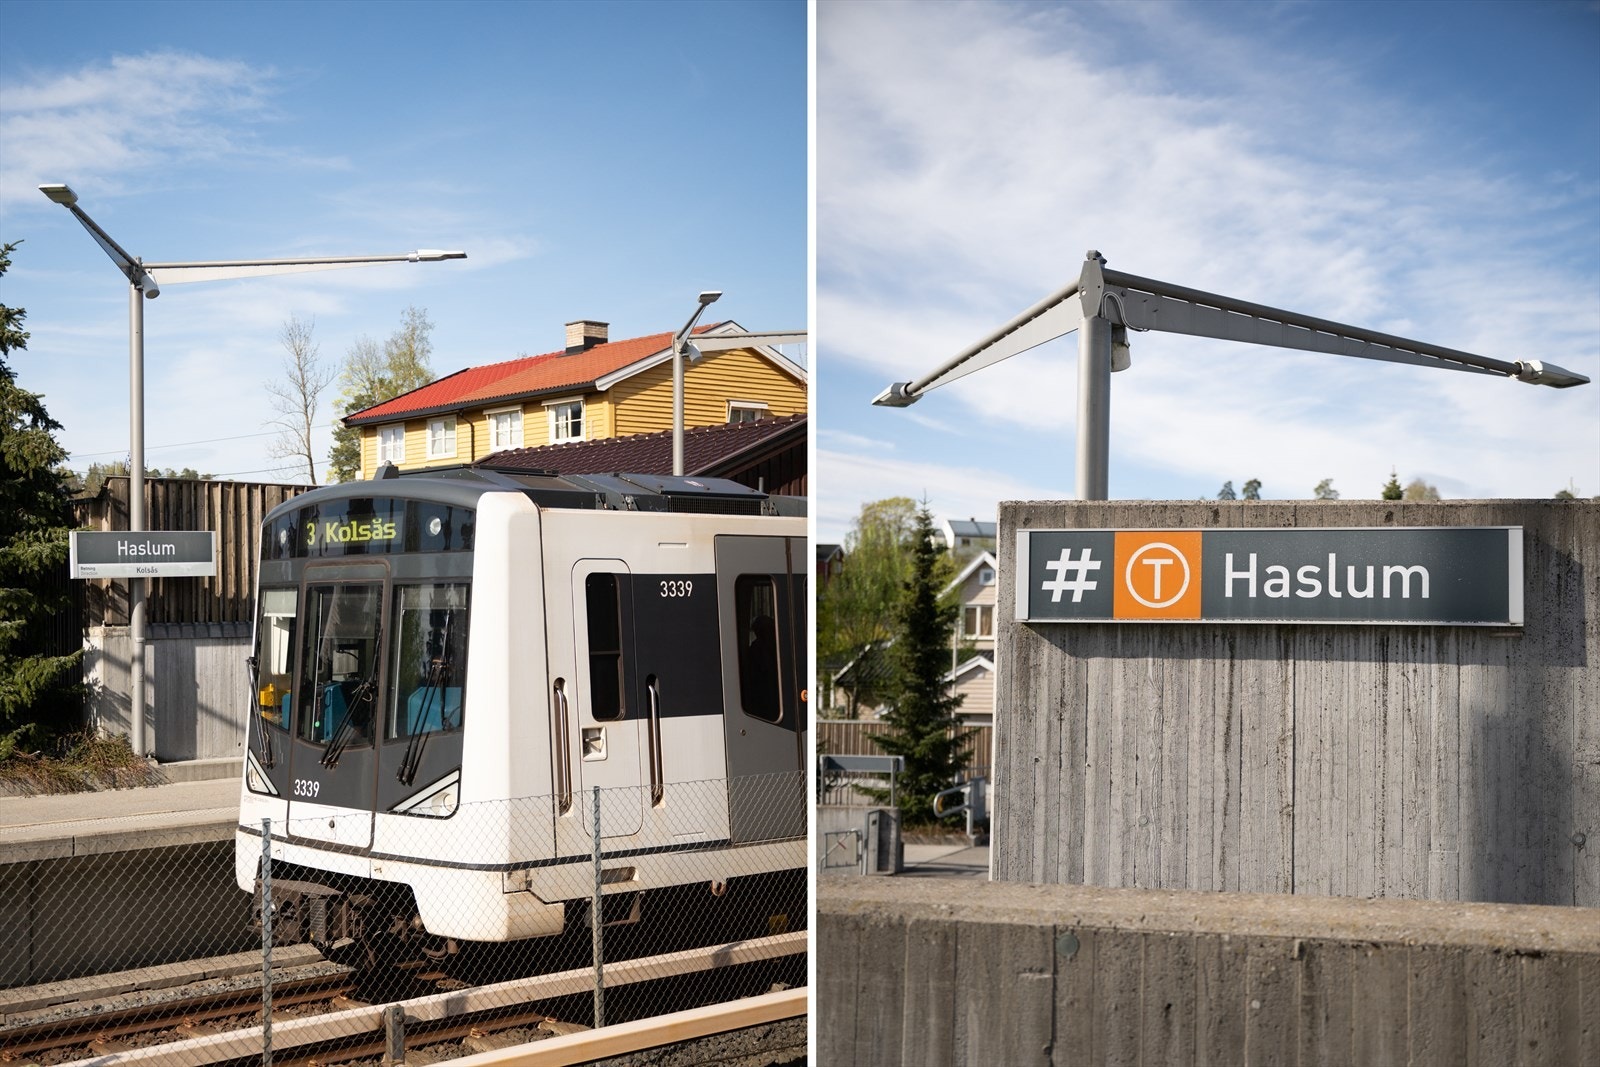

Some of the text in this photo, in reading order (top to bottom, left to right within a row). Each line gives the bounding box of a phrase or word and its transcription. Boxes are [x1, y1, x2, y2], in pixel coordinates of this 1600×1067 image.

[307, 522, 316, 546] 3
[117, 540, 176, 556] Haslum
[136, 566, 159, 574] Kolsås
[1225, 552, 1430, 599] Haslum
[660, 580, 693, 597] 3339
[294, 778, 320, 798] 3339
